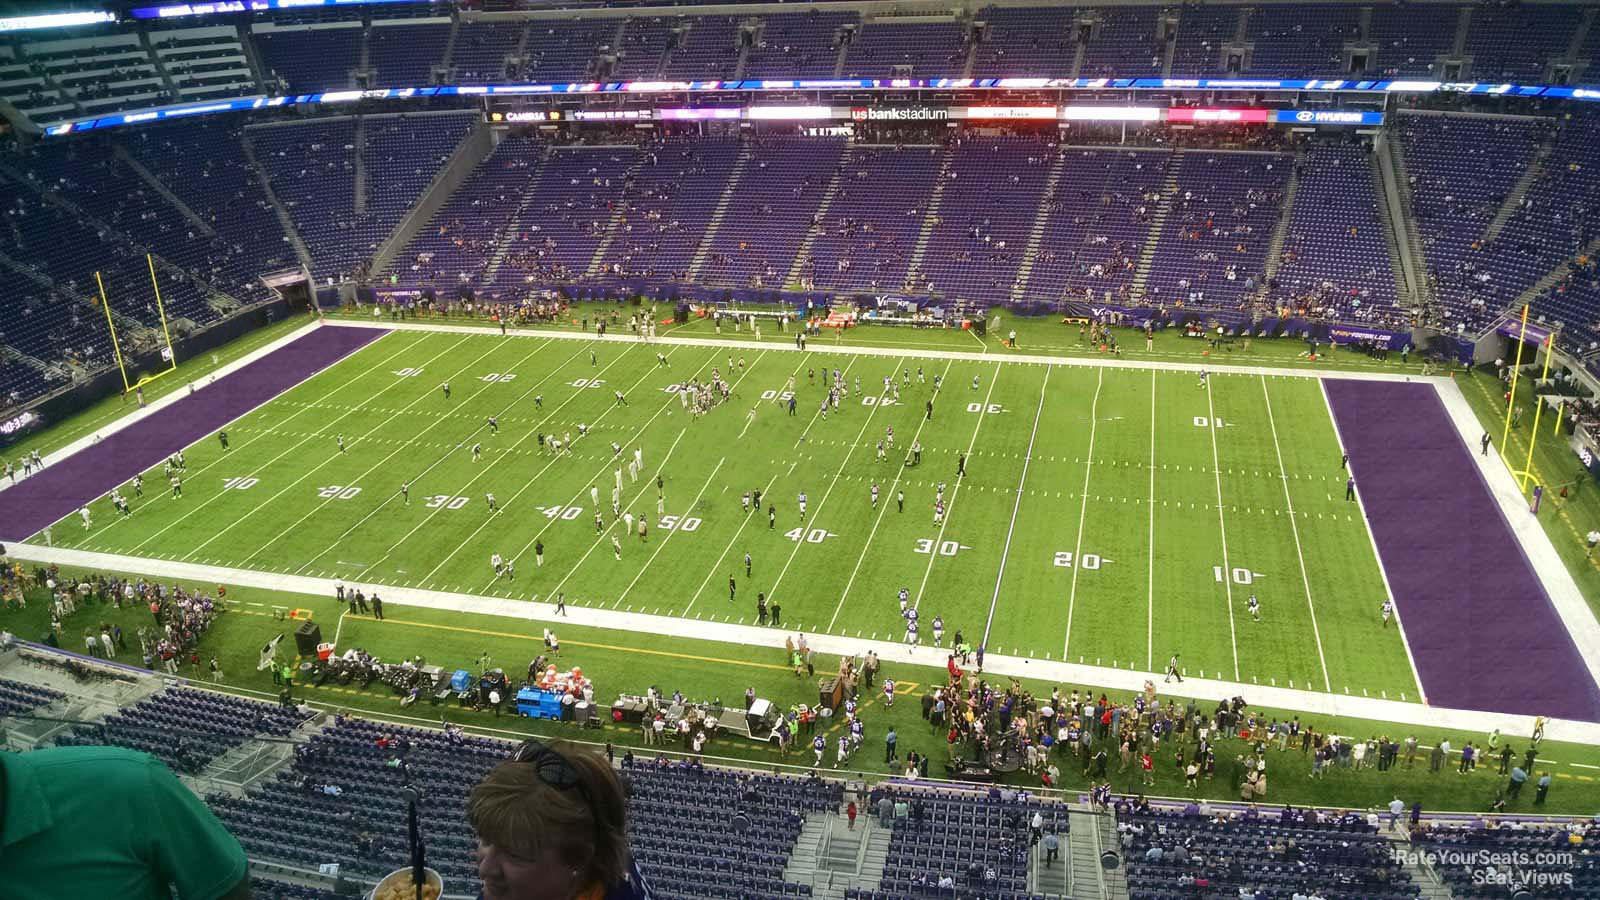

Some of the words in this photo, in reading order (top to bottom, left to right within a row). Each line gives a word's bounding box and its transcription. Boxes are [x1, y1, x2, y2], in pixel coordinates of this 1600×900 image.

[1316, 112, 1362, 122] HYUNDAI
[224, 476, 260, 490] 10
[318, 485, 362, 500] 20
[425, 495, 470, 509] 30
[541, 505, 583, 520] 40
[657, 515, 702, 531] 50
[784, 527, 828, 543] 40
[913, 538, 960, 556] 30
[1054, 551, 1100, 570] 20
[1213, 566, 1252, 585] 10
